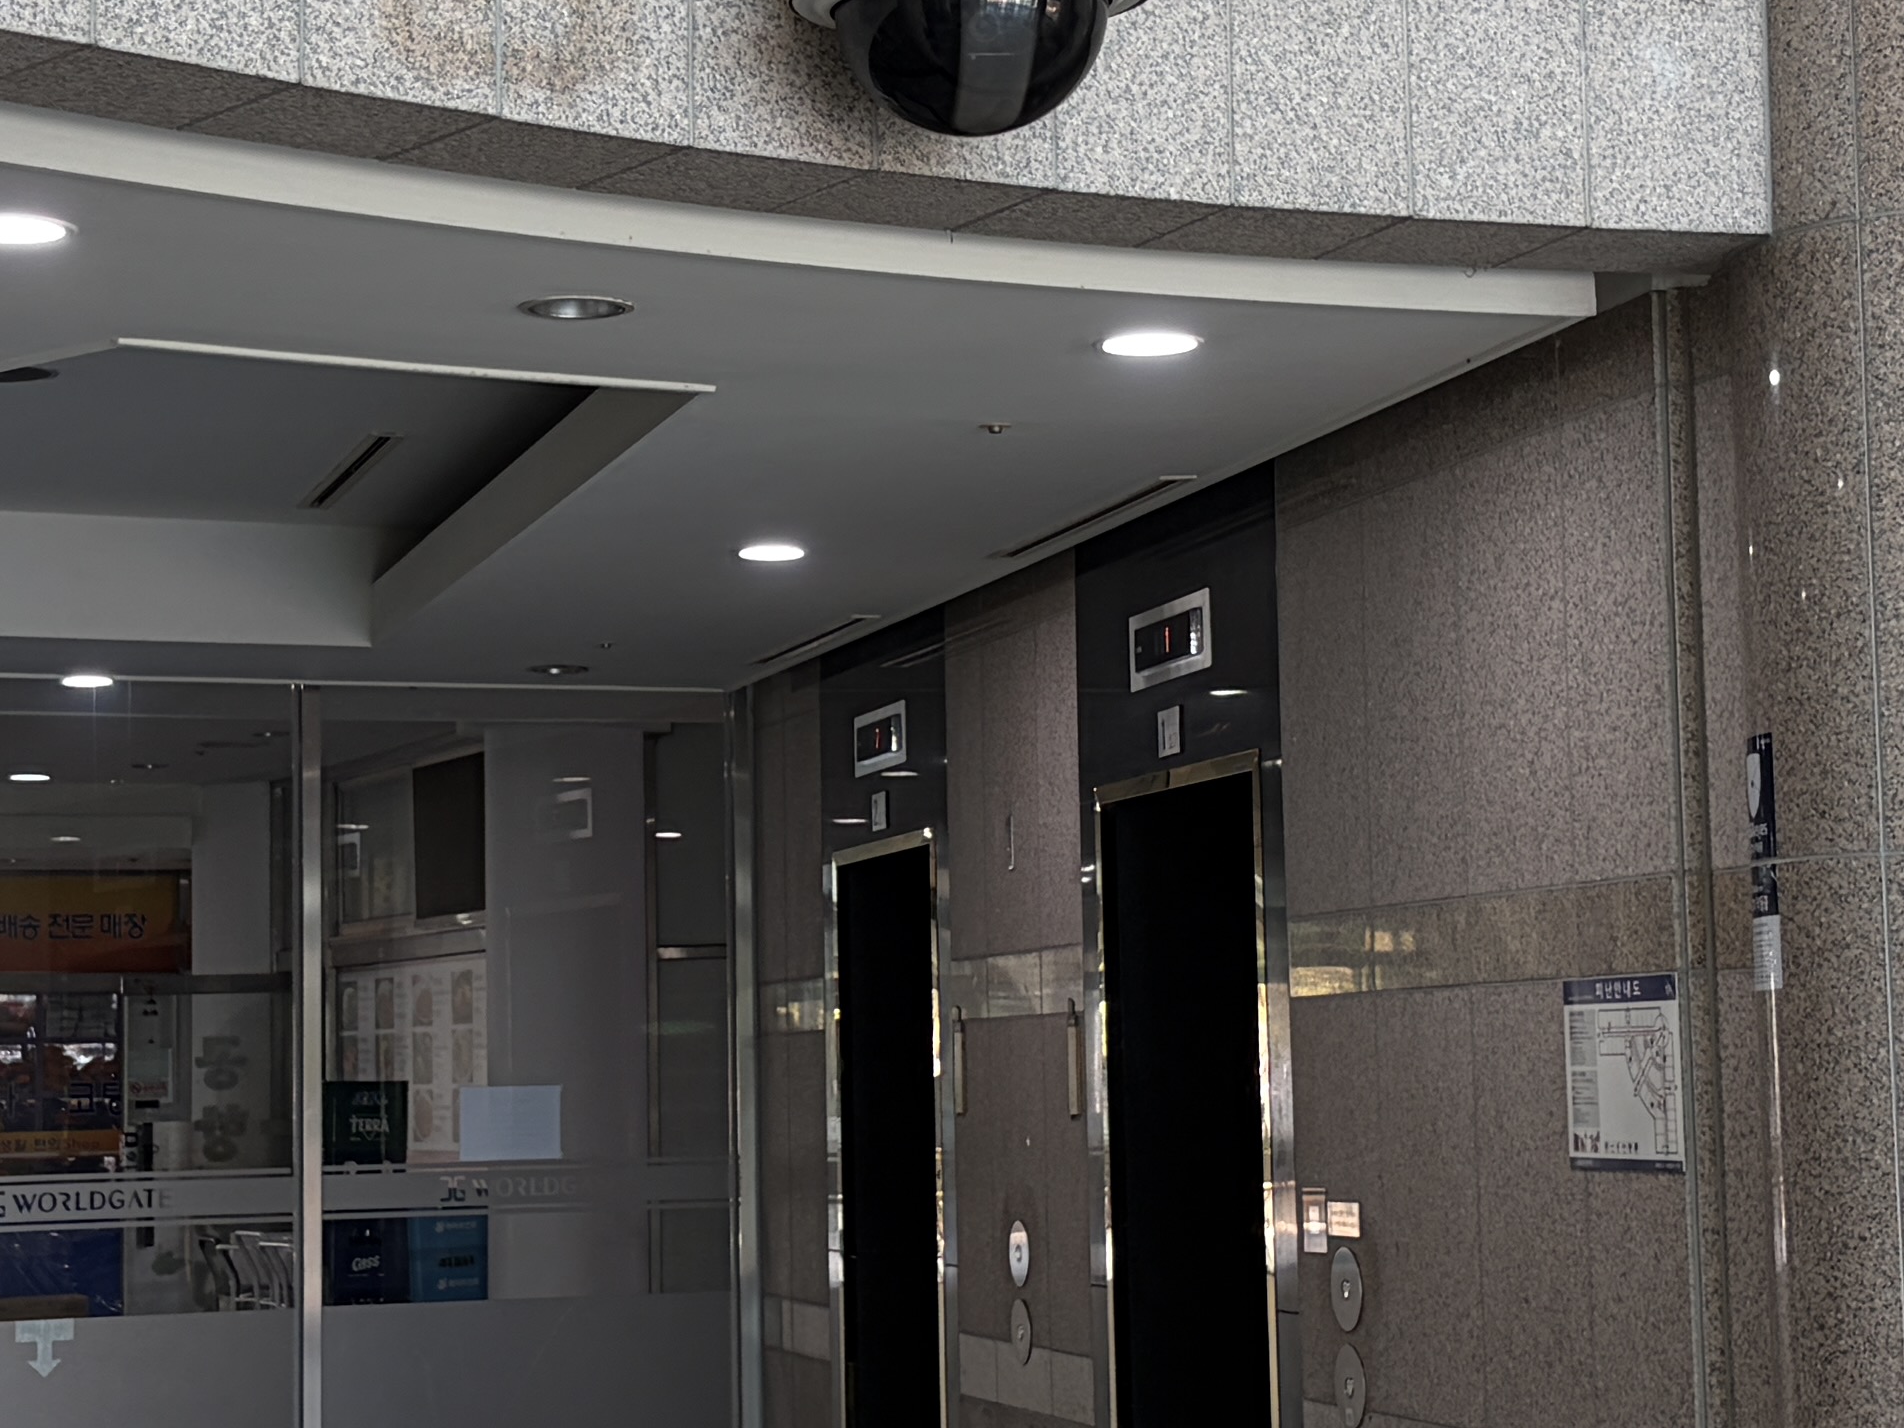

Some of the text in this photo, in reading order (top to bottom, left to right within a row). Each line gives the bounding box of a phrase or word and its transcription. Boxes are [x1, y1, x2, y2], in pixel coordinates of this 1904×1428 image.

[47, 913, 96, 941] 전문
[100, 913, 149, 940] 매장
[349, 1114, 390, 1134] TERRA
[12, 1189, 174, 1214] WORLDGATE
